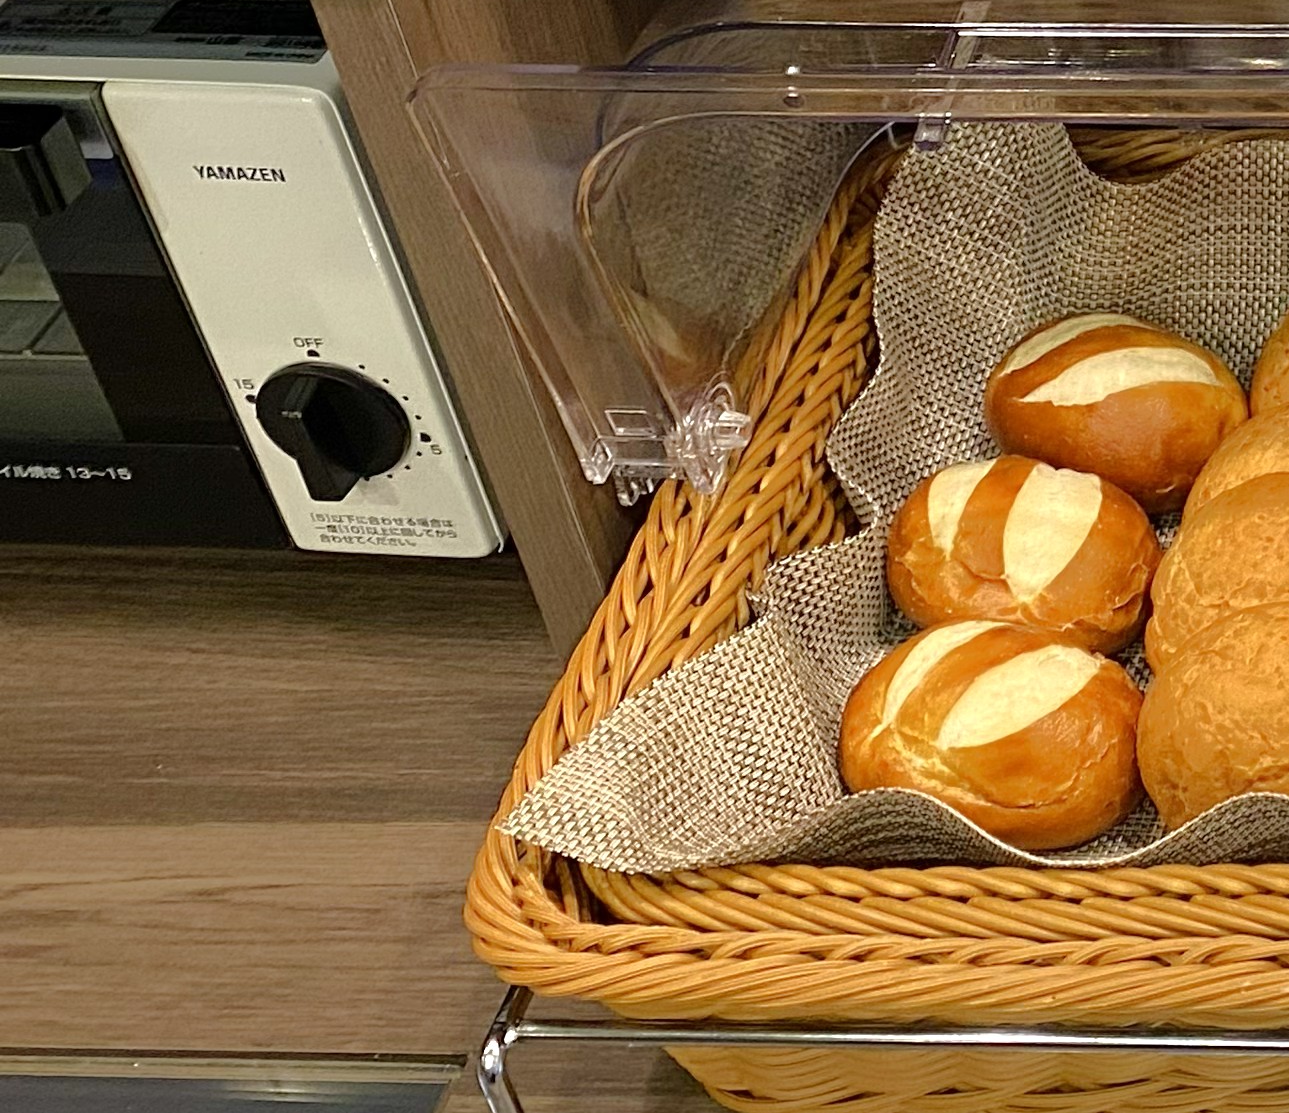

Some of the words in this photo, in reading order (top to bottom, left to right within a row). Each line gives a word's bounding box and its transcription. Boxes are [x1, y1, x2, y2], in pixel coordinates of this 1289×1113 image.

[192, 165, 287, 183] YAMAZEN
[293, 337, 324, 349] OFF
[233, 378, 255, 390] 15
[430, 444, 443, 456] 5
